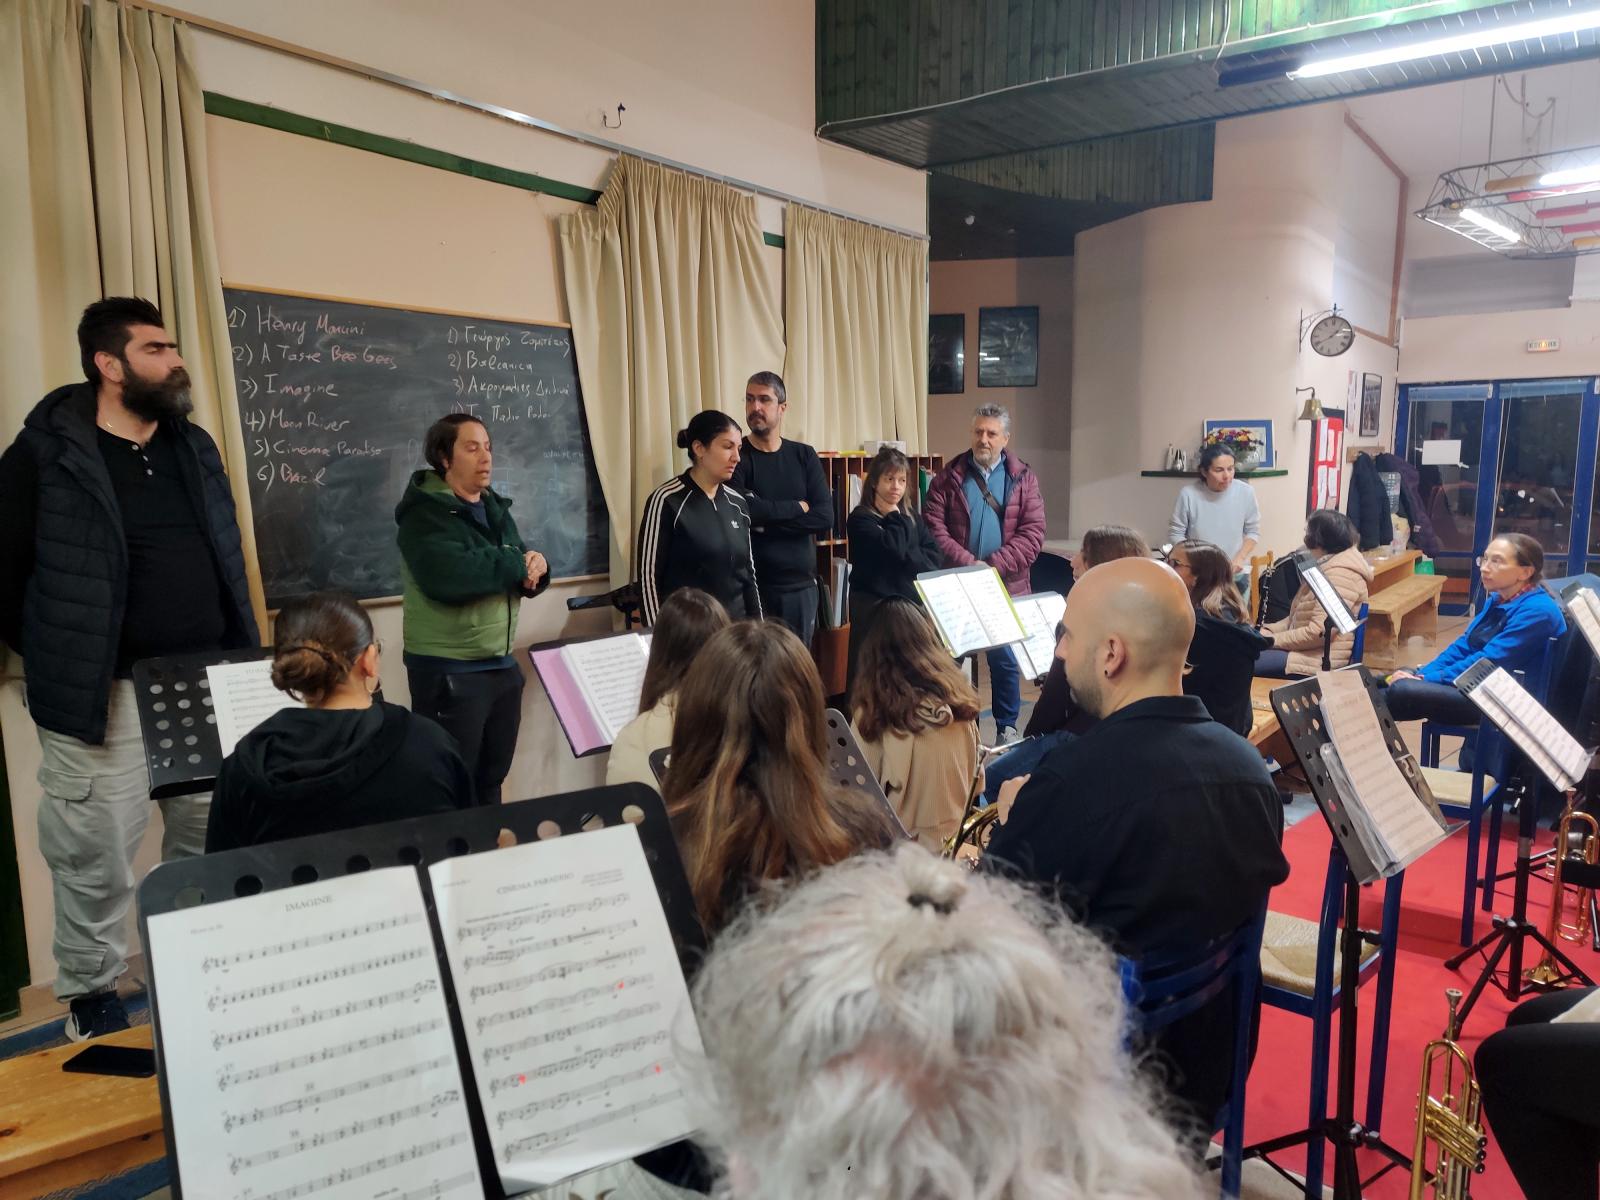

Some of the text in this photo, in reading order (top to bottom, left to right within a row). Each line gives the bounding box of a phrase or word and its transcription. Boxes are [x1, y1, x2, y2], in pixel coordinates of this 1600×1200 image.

[232, 344, 254, 367] 2)
[261, 341, 272, 365] A
[275, 343, 322, 363] Taste
[330, 344, 358, 363] Bee
[239, 373, 339, 403] 3) Imagine
[244, 408, 266, 433] 4)
[306, 411, 351, 432] River
[253, 437, 270, 458] 5)
[272, 439, 331, 457] Cinema
[256, 460, 276, 493] 6)
[284, 895, 333, 912] IMAGINE
